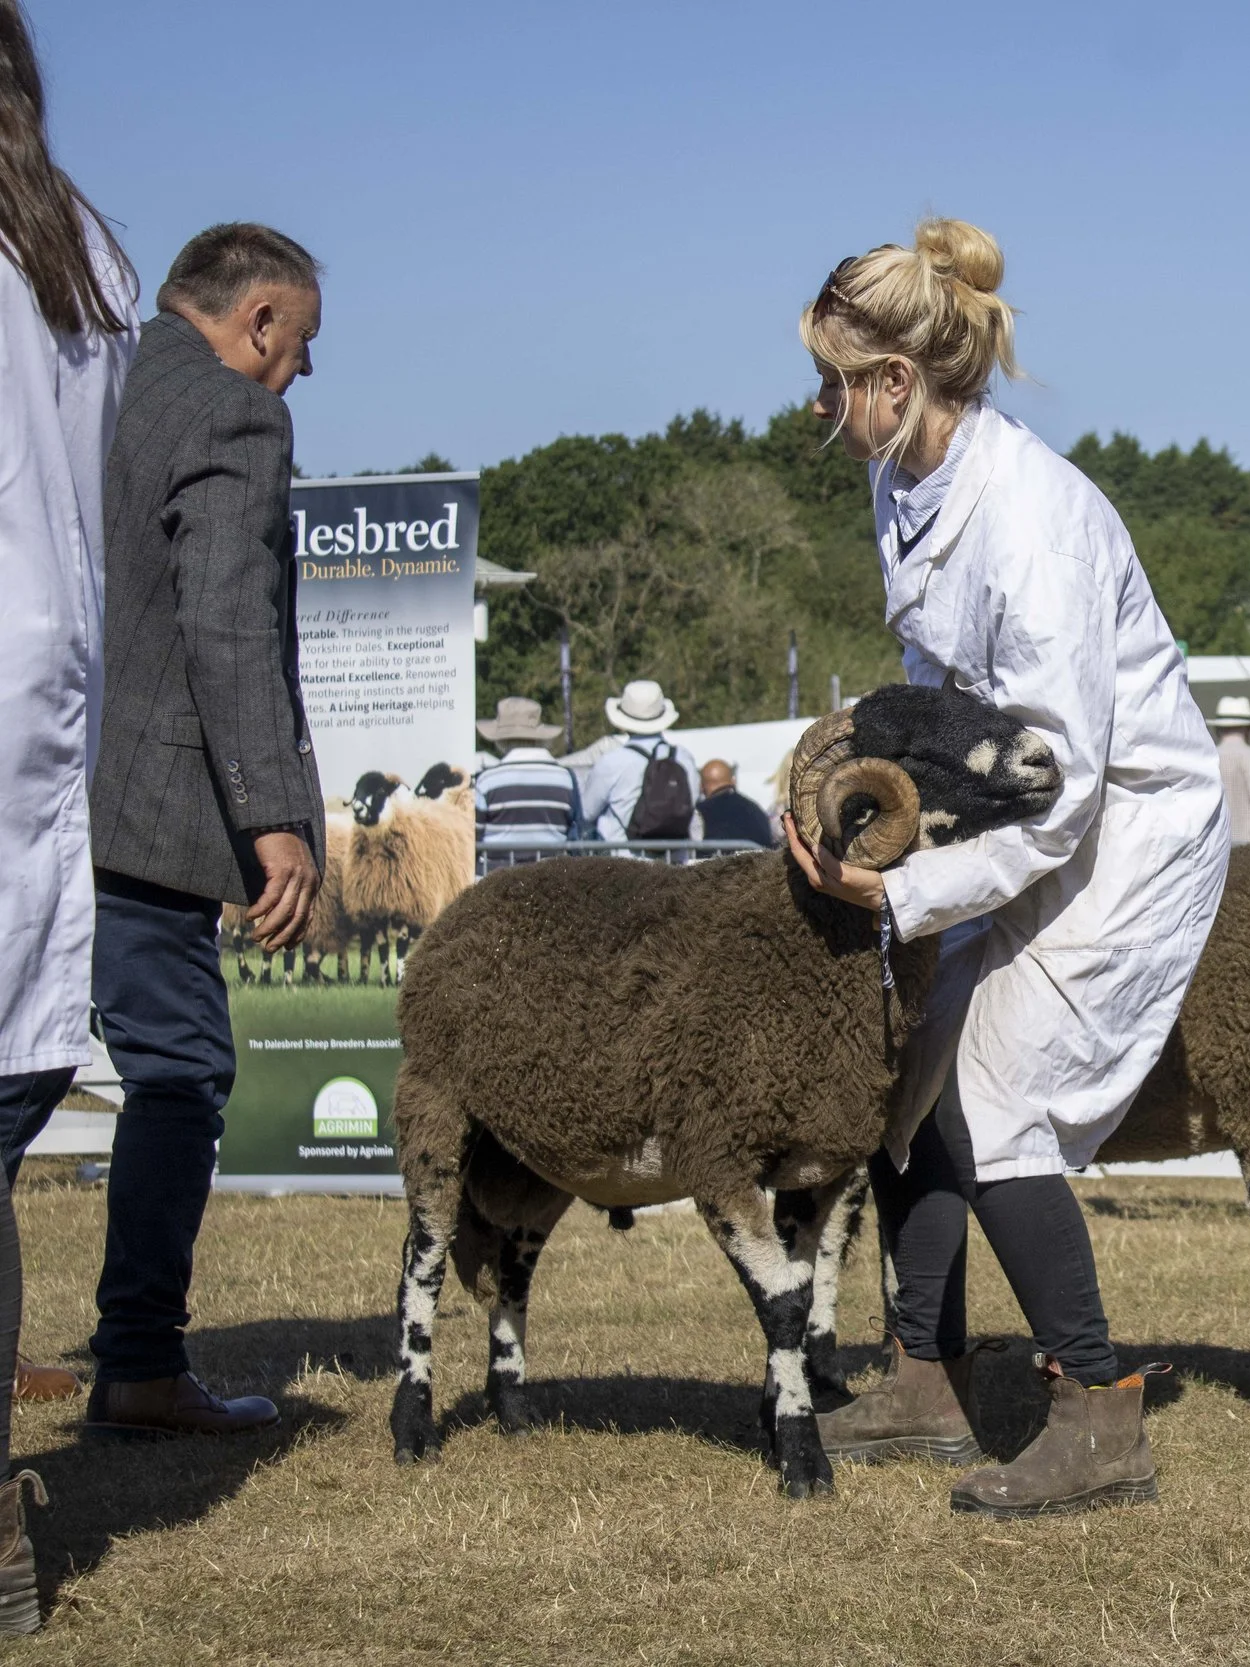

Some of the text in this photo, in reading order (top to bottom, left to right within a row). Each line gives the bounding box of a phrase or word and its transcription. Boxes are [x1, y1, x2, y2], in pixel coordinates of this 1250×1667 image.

[293, 502, 460, 557] lesbred
[303, 555, 460, 580] Durable. Dynamic.
[297, 608, 390, 624] red Difference
[342, 627, 382, 639] Thriving
[385, 626, 394, 636] in
[397, 625, 413, 635] the
[415, 624, 449, 636] rugged
[305, 643, 352, 654] Yorkshire
[355, 641, 385, 652] Dales.
[388, 638, 444, 652] Exceptional
[315, 659, 328, 669] for
[332, 658, 355, 668] their
[359, 656, 390, 668] ability
[393, 656, 402, 665] to
[405, 656, 431, 667] graze
[434, 654, 446, 663] on
[300, 668, 456, 684] Maternal Excellence. Renowned
[308, 687, 360, 699] mothering
[363, 686, 404, 696] instincts
[407, 684, 425, 694] and
[429, 683, 450, 695] high
[330, 703, 337, 712] A
[339, 701, 370, 713] Living
[337, 717, 355, 727] and
[359, 715, 414, 728] agricultural
[249, 1039, 263, 1049] The
[265, 1039, 302, 1049] Dalesbred
[305, 1039, 329, 1050] Sheep
[331, 1039, 365, 1048] Breeders
[318, 1120, 373, 1134] AGRIMIN
[299, 1144, 394, 1159] Sponsored by Agrimin
